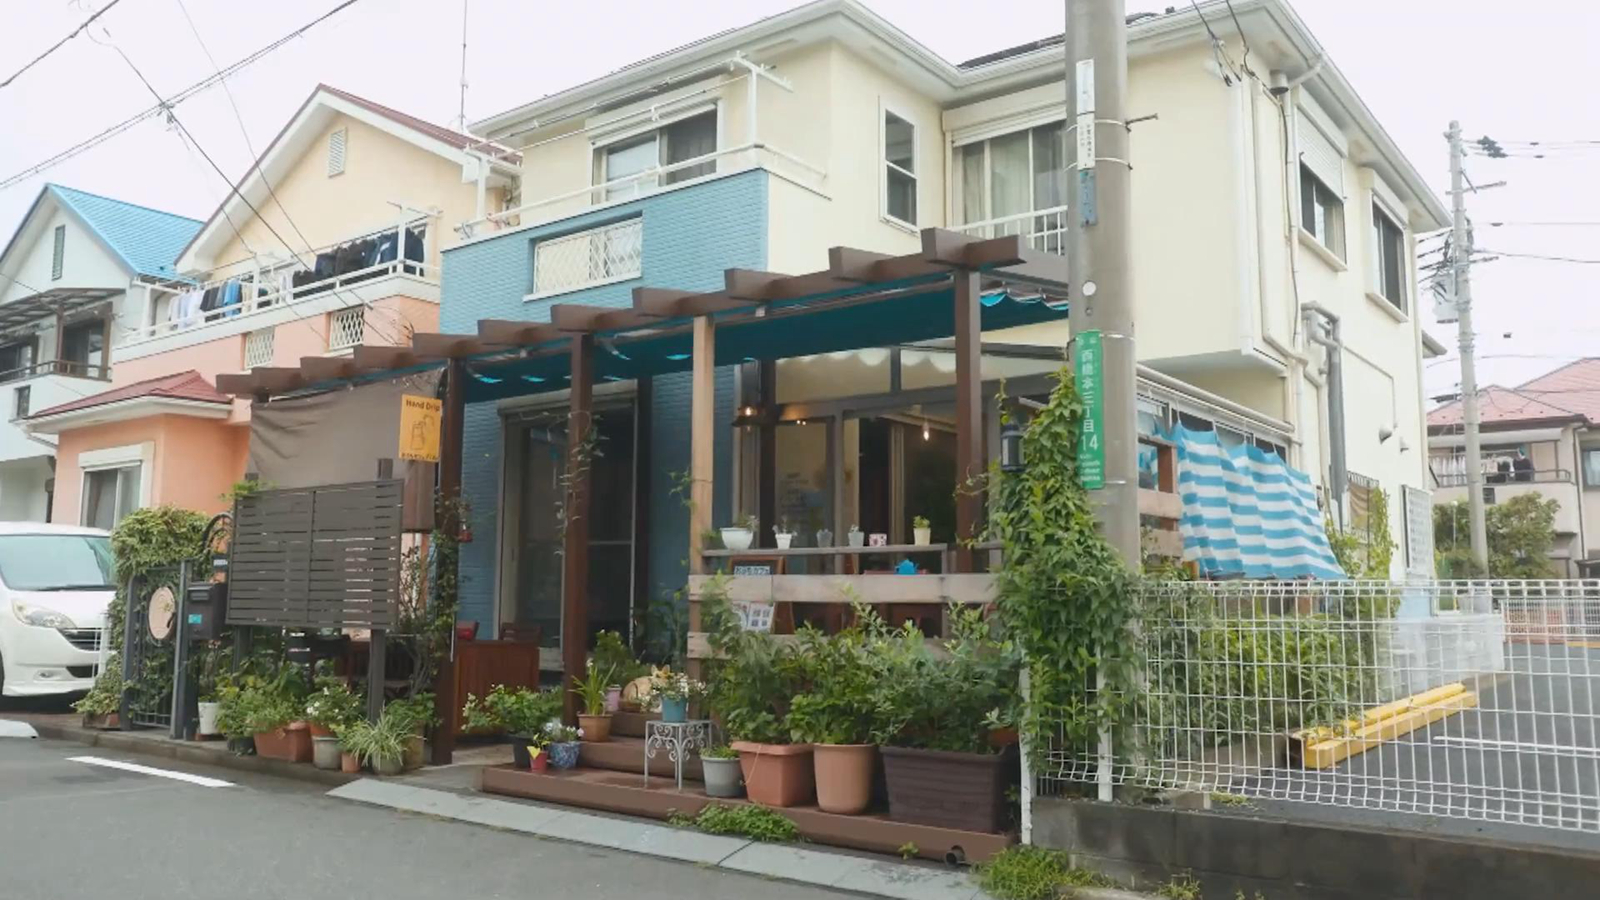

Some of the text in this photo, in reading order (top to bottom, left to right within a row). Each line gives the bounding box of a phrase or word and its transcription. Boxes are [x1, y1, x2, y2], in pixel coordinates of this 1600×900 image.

[406, 399, 440, 412] Hand Drip
[1081, 434, 1099, 451] 14
